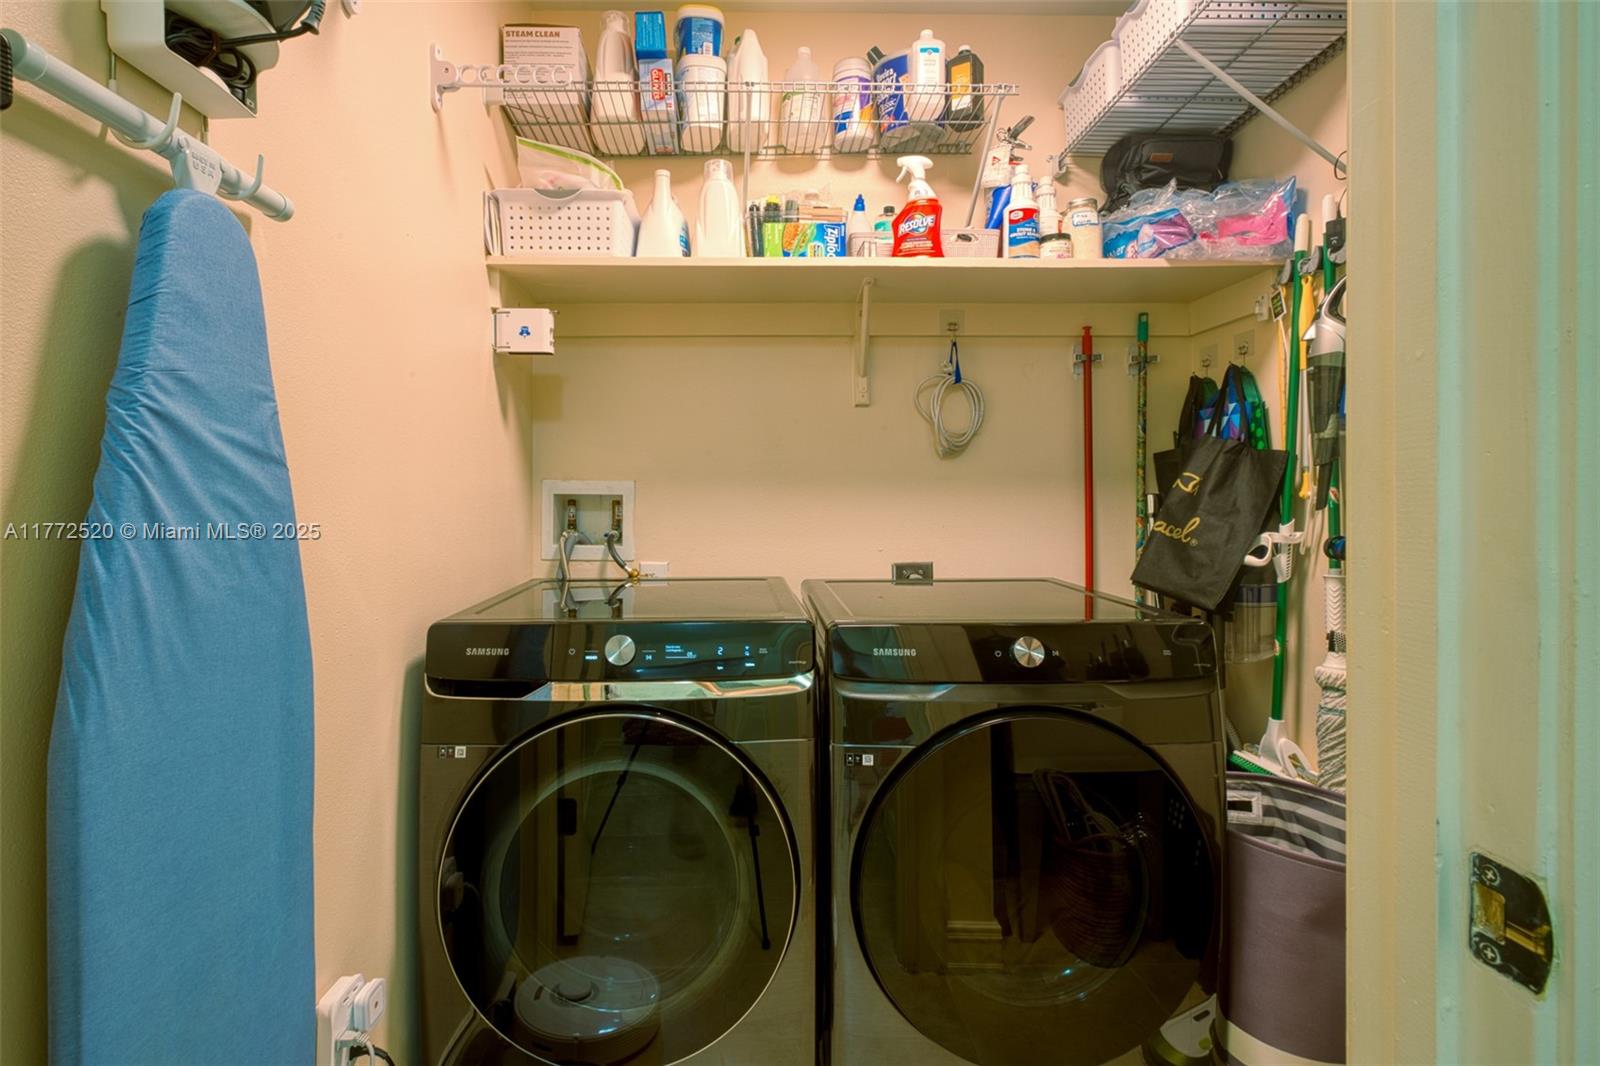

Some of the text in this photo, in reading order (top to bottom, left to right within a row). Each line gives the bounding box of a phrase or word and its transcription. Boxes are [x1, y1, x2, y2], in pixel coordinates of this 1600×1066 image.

[505, 30, 561, 38] STEAM CLEAN
[898, 215, 936, 237] RESOLVE
[465, 646, 510, 657] SAMSUNG
[872, 647, 917, 657] SAMSUNG
